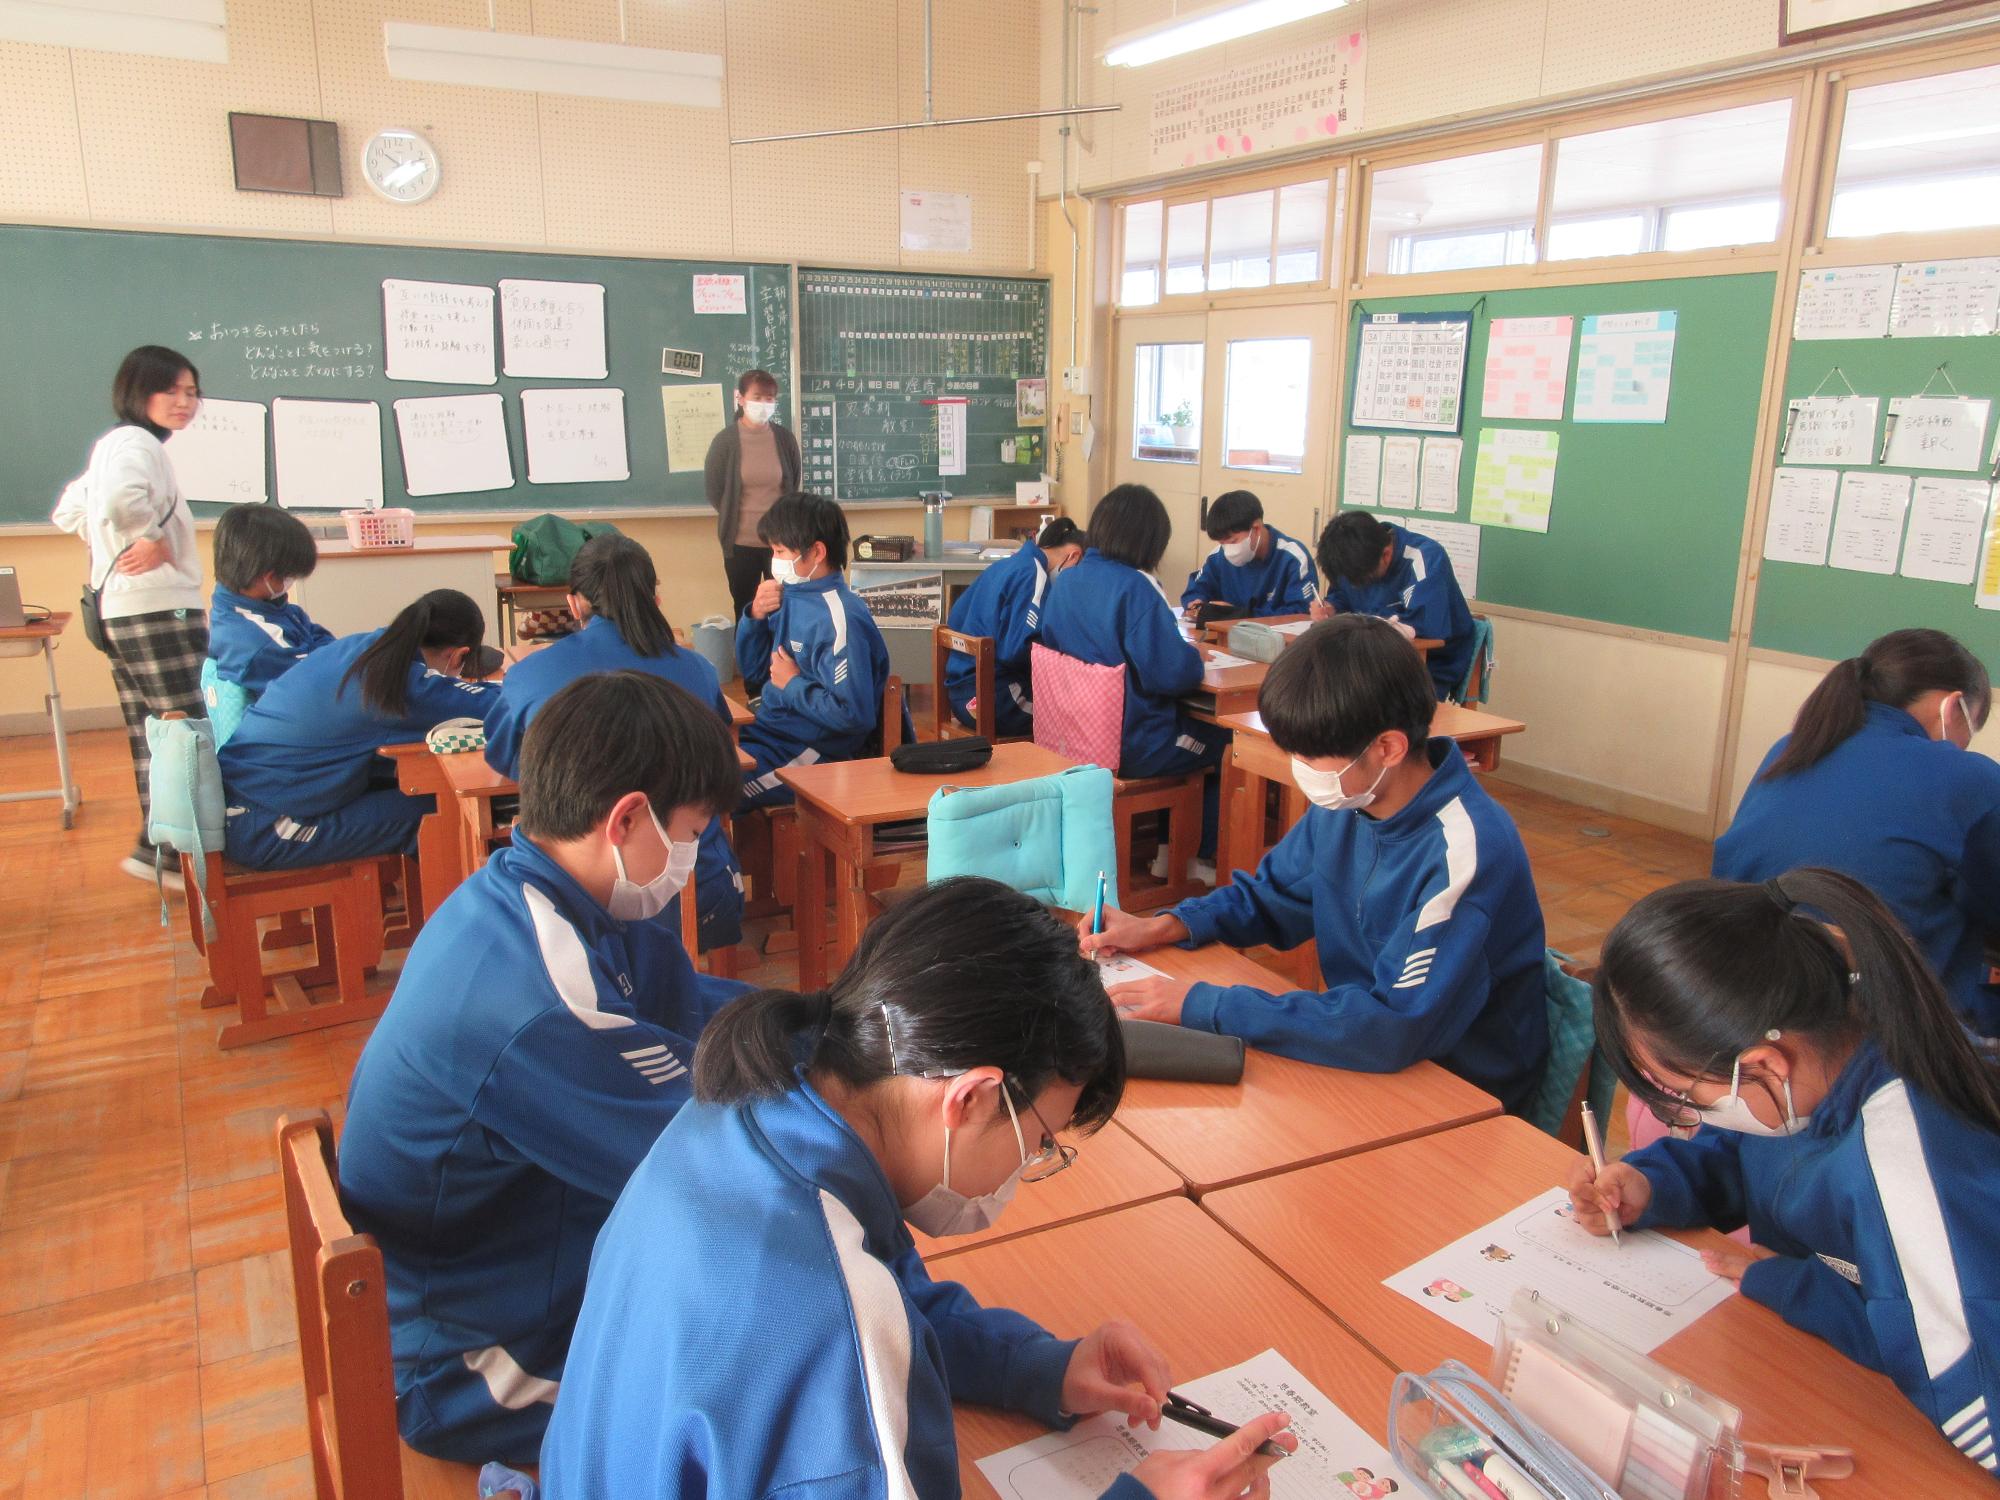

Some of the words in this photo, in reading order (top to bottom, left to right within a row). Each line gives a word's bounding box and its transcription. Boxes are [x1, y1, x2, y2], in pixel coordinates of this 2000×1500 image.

[812, 438, 833, 449] 数学
[812, 484, 833, 496] 社会
[1278, 1382, 1319, 1417] 思春期教室
